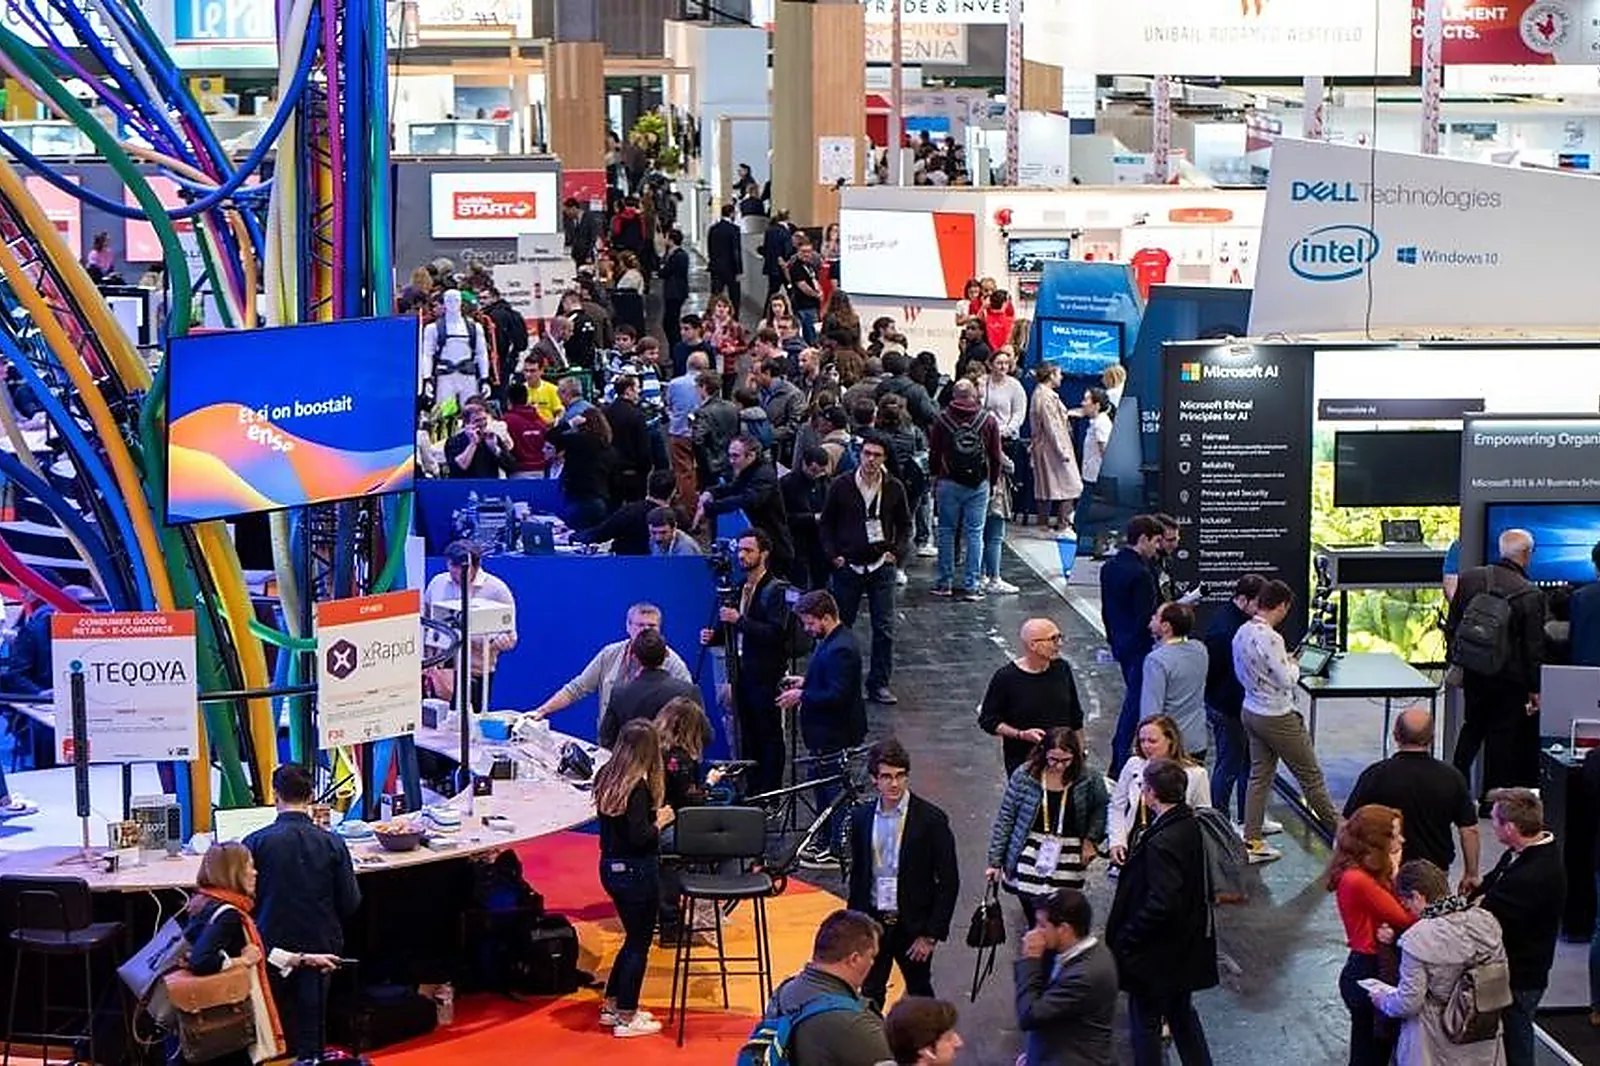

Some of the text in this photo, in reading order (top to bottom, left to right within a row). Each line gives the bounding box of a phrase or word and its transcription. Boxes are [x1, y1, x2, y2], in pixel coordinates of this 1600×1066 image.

[1291, 181, 1502, 211] DELL Technologies
[457, 204, 514, 216] START
[1302, 238, 1364, 263] intel
[1422, 250, 1498, 265] Windows 10
[1203, 365, 1278, 378] Microsoft AI
[272, 405, 291, 419] on
[294, 395, 352, 417] boostait
[1180, 401, 1222, 410] Microsoft
[1180, 412, 1222, 422] Principles
[1474, 431, 1556, 448] Empowering
[363, 633, 416, 663] xRapid
[91, 661, 187, 687] TEQOYA
